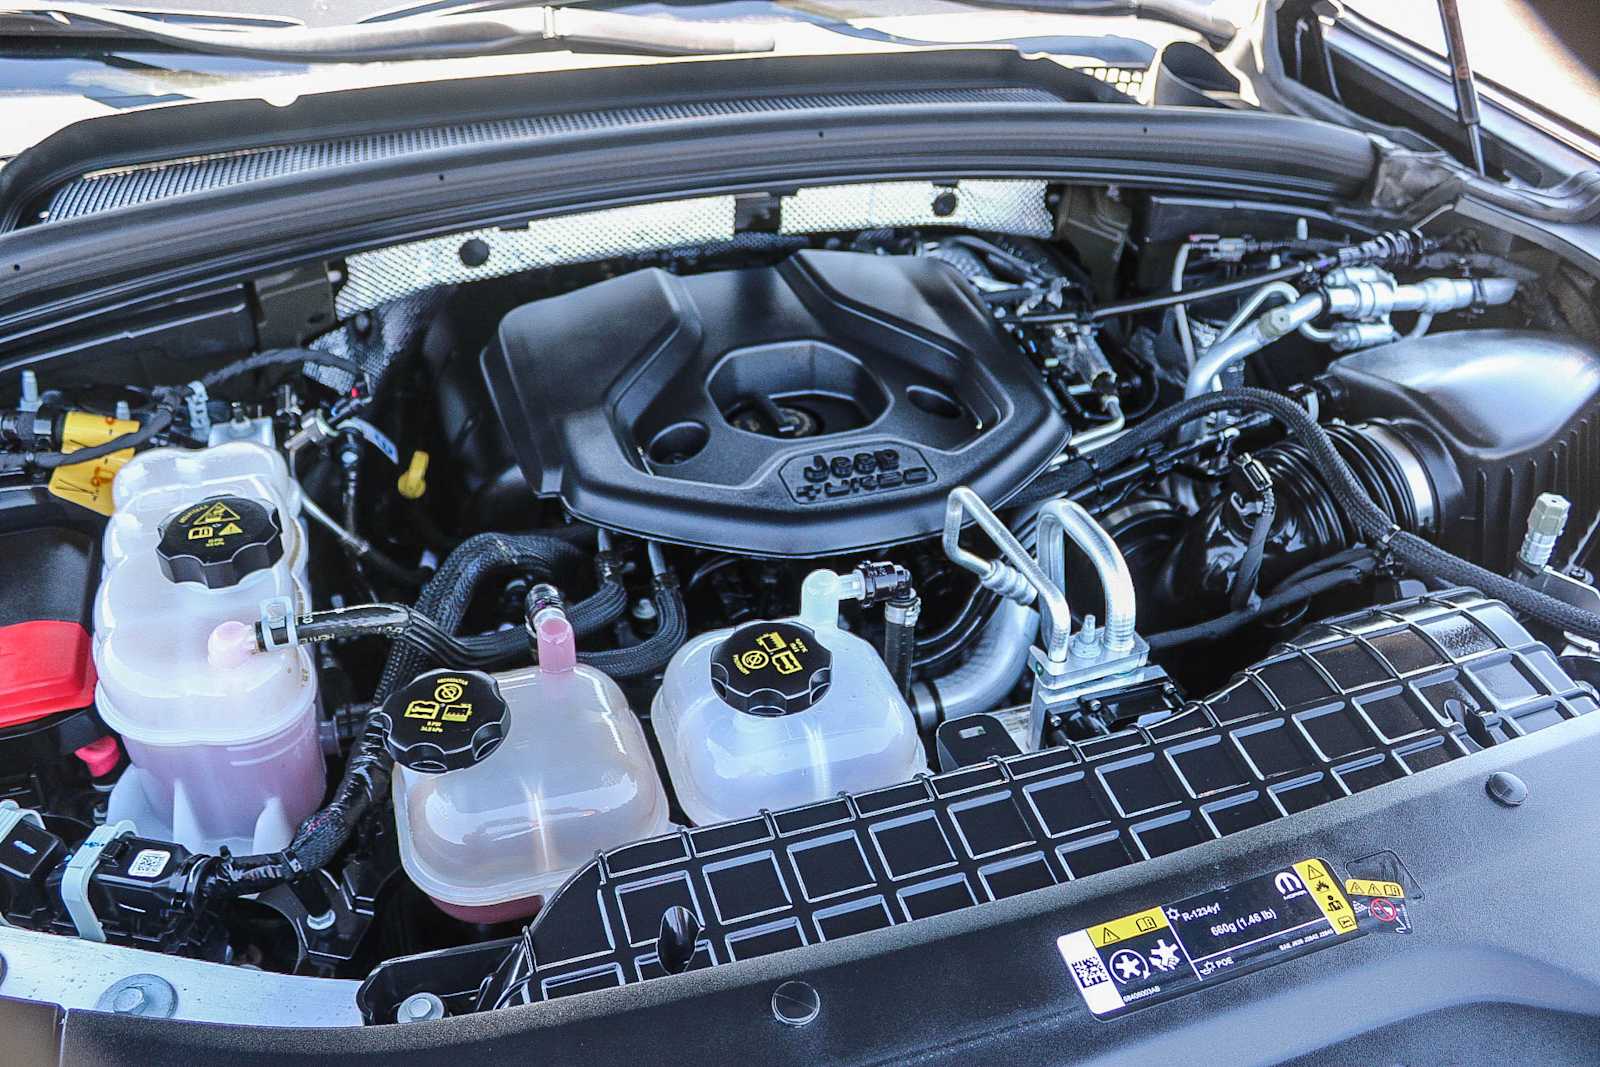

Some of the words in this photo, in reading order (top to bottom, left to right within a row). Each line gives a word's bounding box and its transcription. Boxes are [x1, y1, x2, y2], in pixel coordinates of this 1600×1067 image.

[803, 449, 899, 483] Jeep
[1182, 903, 1221, 922] R-1234yf
[1210, 920, 1237, 937] 660g
[1237, 912, 1261, 930] (1.46
[1261, 908, 1278, 925] lb)
[1215, 956, 1234, 969] POE
